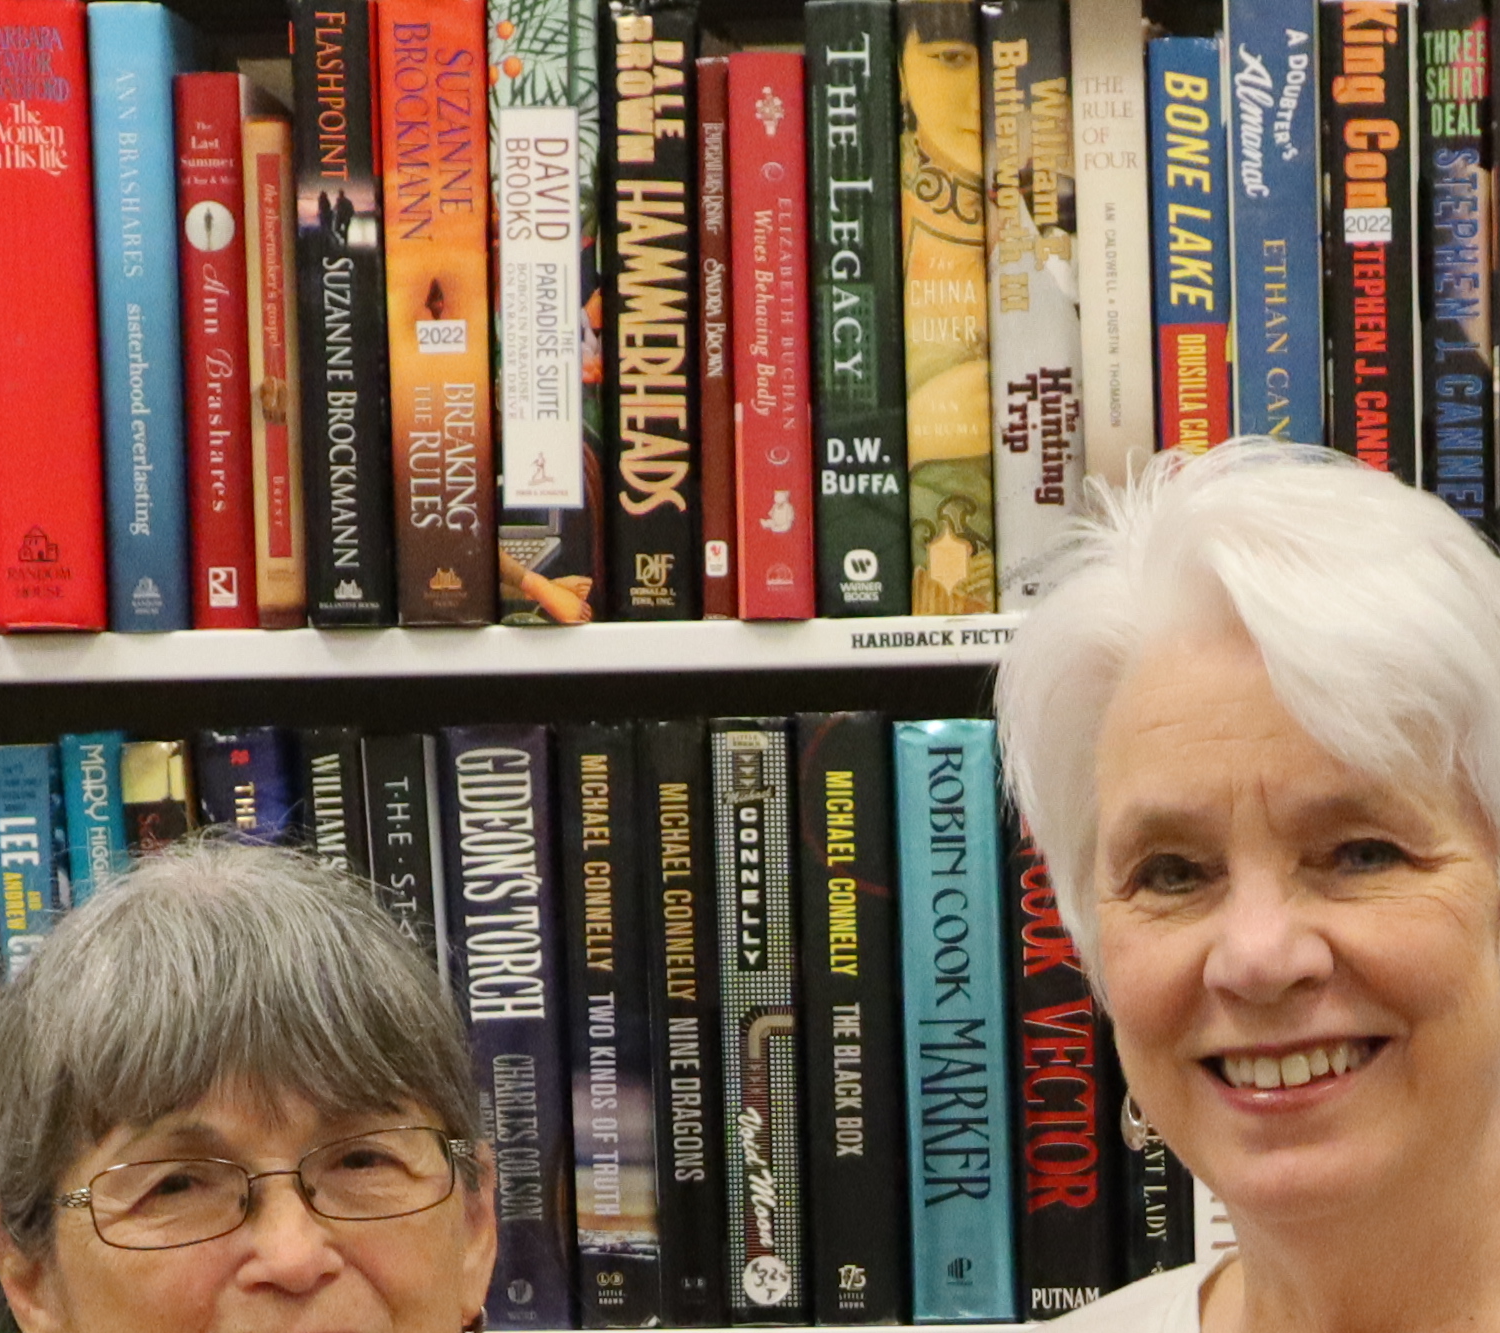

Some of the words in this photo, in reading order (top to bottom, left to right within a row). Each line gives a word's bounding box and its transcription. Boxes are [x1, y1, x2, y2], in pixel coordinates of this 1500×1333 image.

[616, 16, 655, 164] BROWN
[652, 41, 685, 141] DALE
[825, 32, 871, 164] THE
[1162, 70, 1211, 195] BONE
[829, 174, 874, 382] LEGACY
[1168, 201, 1215, 311] LAKE
[126, 303, 150, 415] sisterhood
[322, 256, 354, 382] SUZANNE
[419, 328, 464, 346] 2022
[616, 179, 689, 516] HAMMERHEADS
[129, 422, 152, 537] everlasting
[326, 391, 359, 568] BROCKMANN
[821, 470, 899, 498] BUFFA
[827, 439, 889, 464] D.W.
[455, 746, 544, 905] GIDEON'S
[825, 770, 856, 874] MICHAEL
[926, 744, 966, 879] ROBIN
[466, 910, 546, 1021] TORCH
[828, 879, 859, 978] CONNELLY
[931, 888, 971, 1007] COOK
[832, 1002, 860, 1041] THE
[834, 1046, 862, 1107] BLACK
[835, 1111, 864, 1157] BOX
[919, 1018, 991, 1208] MARKER
[1021, 996, 1099, 1214] VECTOR
